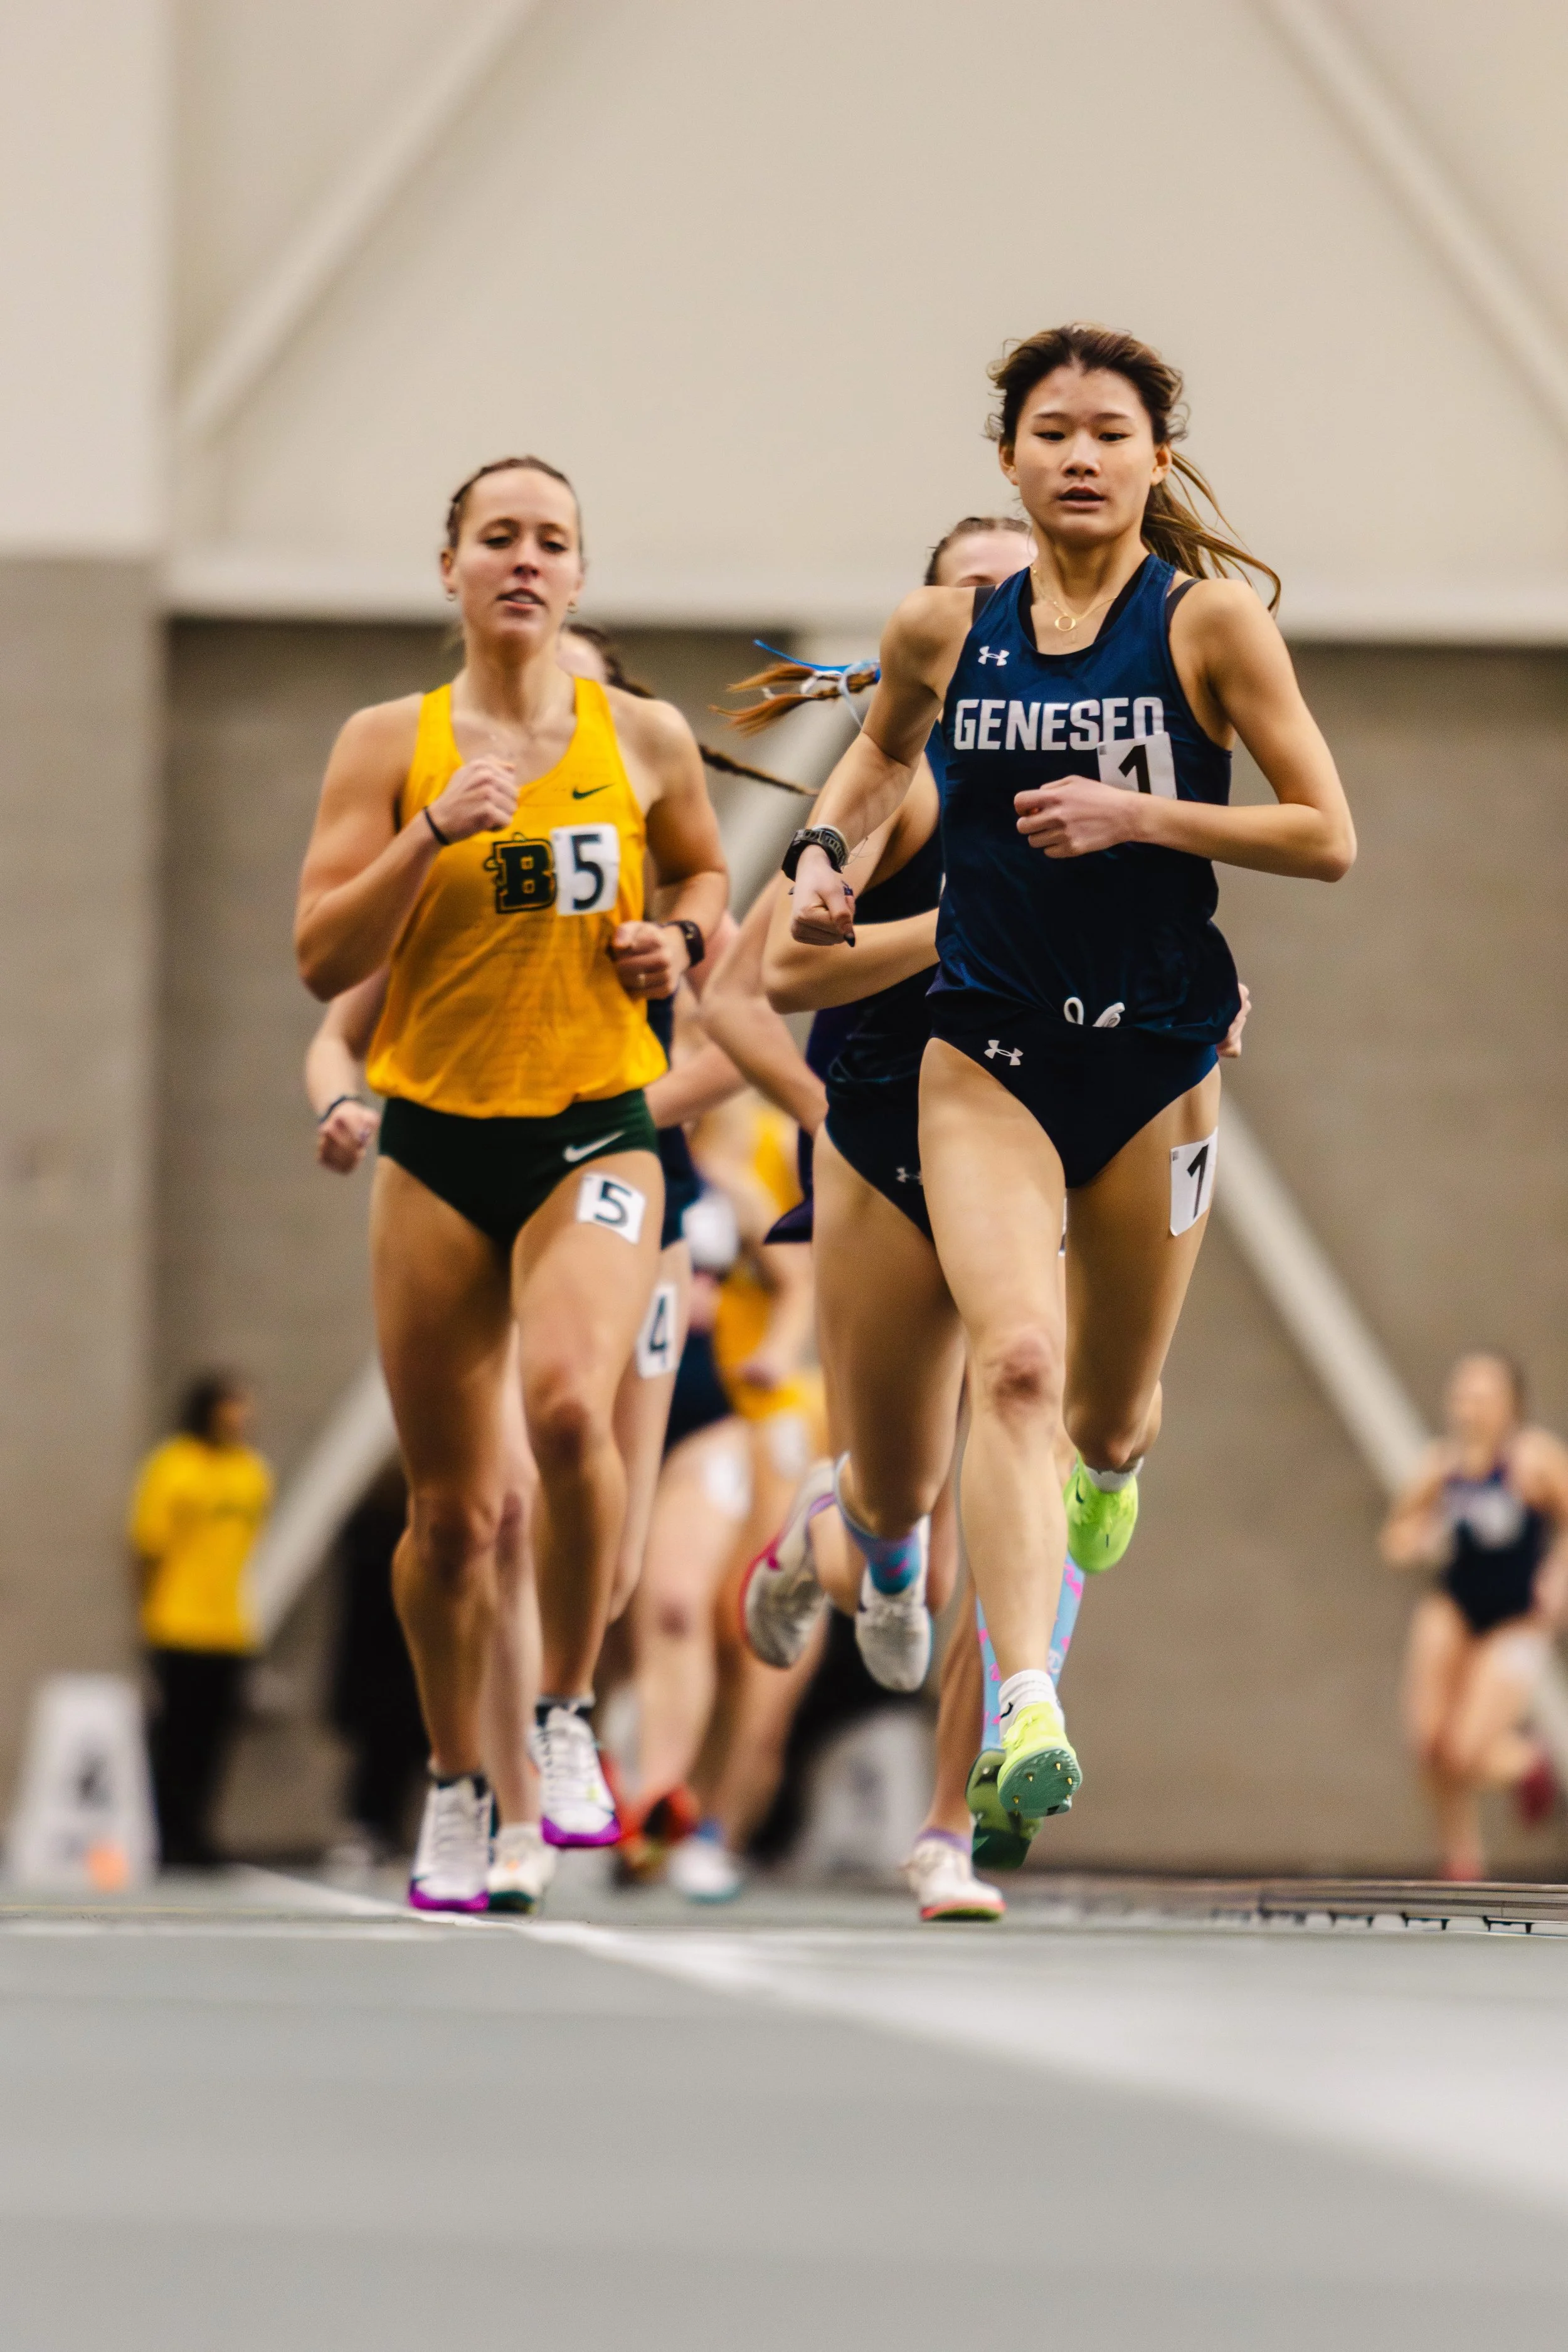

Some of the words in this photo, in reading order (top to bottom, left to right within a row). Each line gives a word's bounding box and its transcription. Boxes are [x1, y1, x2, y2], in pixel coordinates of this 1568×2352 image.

[955, 697, 1164, 750] GENESEO
[1118, 744, 1151, 794] 1
[492, 839, 557, 913] B
[570, 834, 604, 911] 5
[594, 1180, 631, 1227] 5
[1187, 1144, 1209, 1219] 1
[649, 1294, 668, 1367] 4
